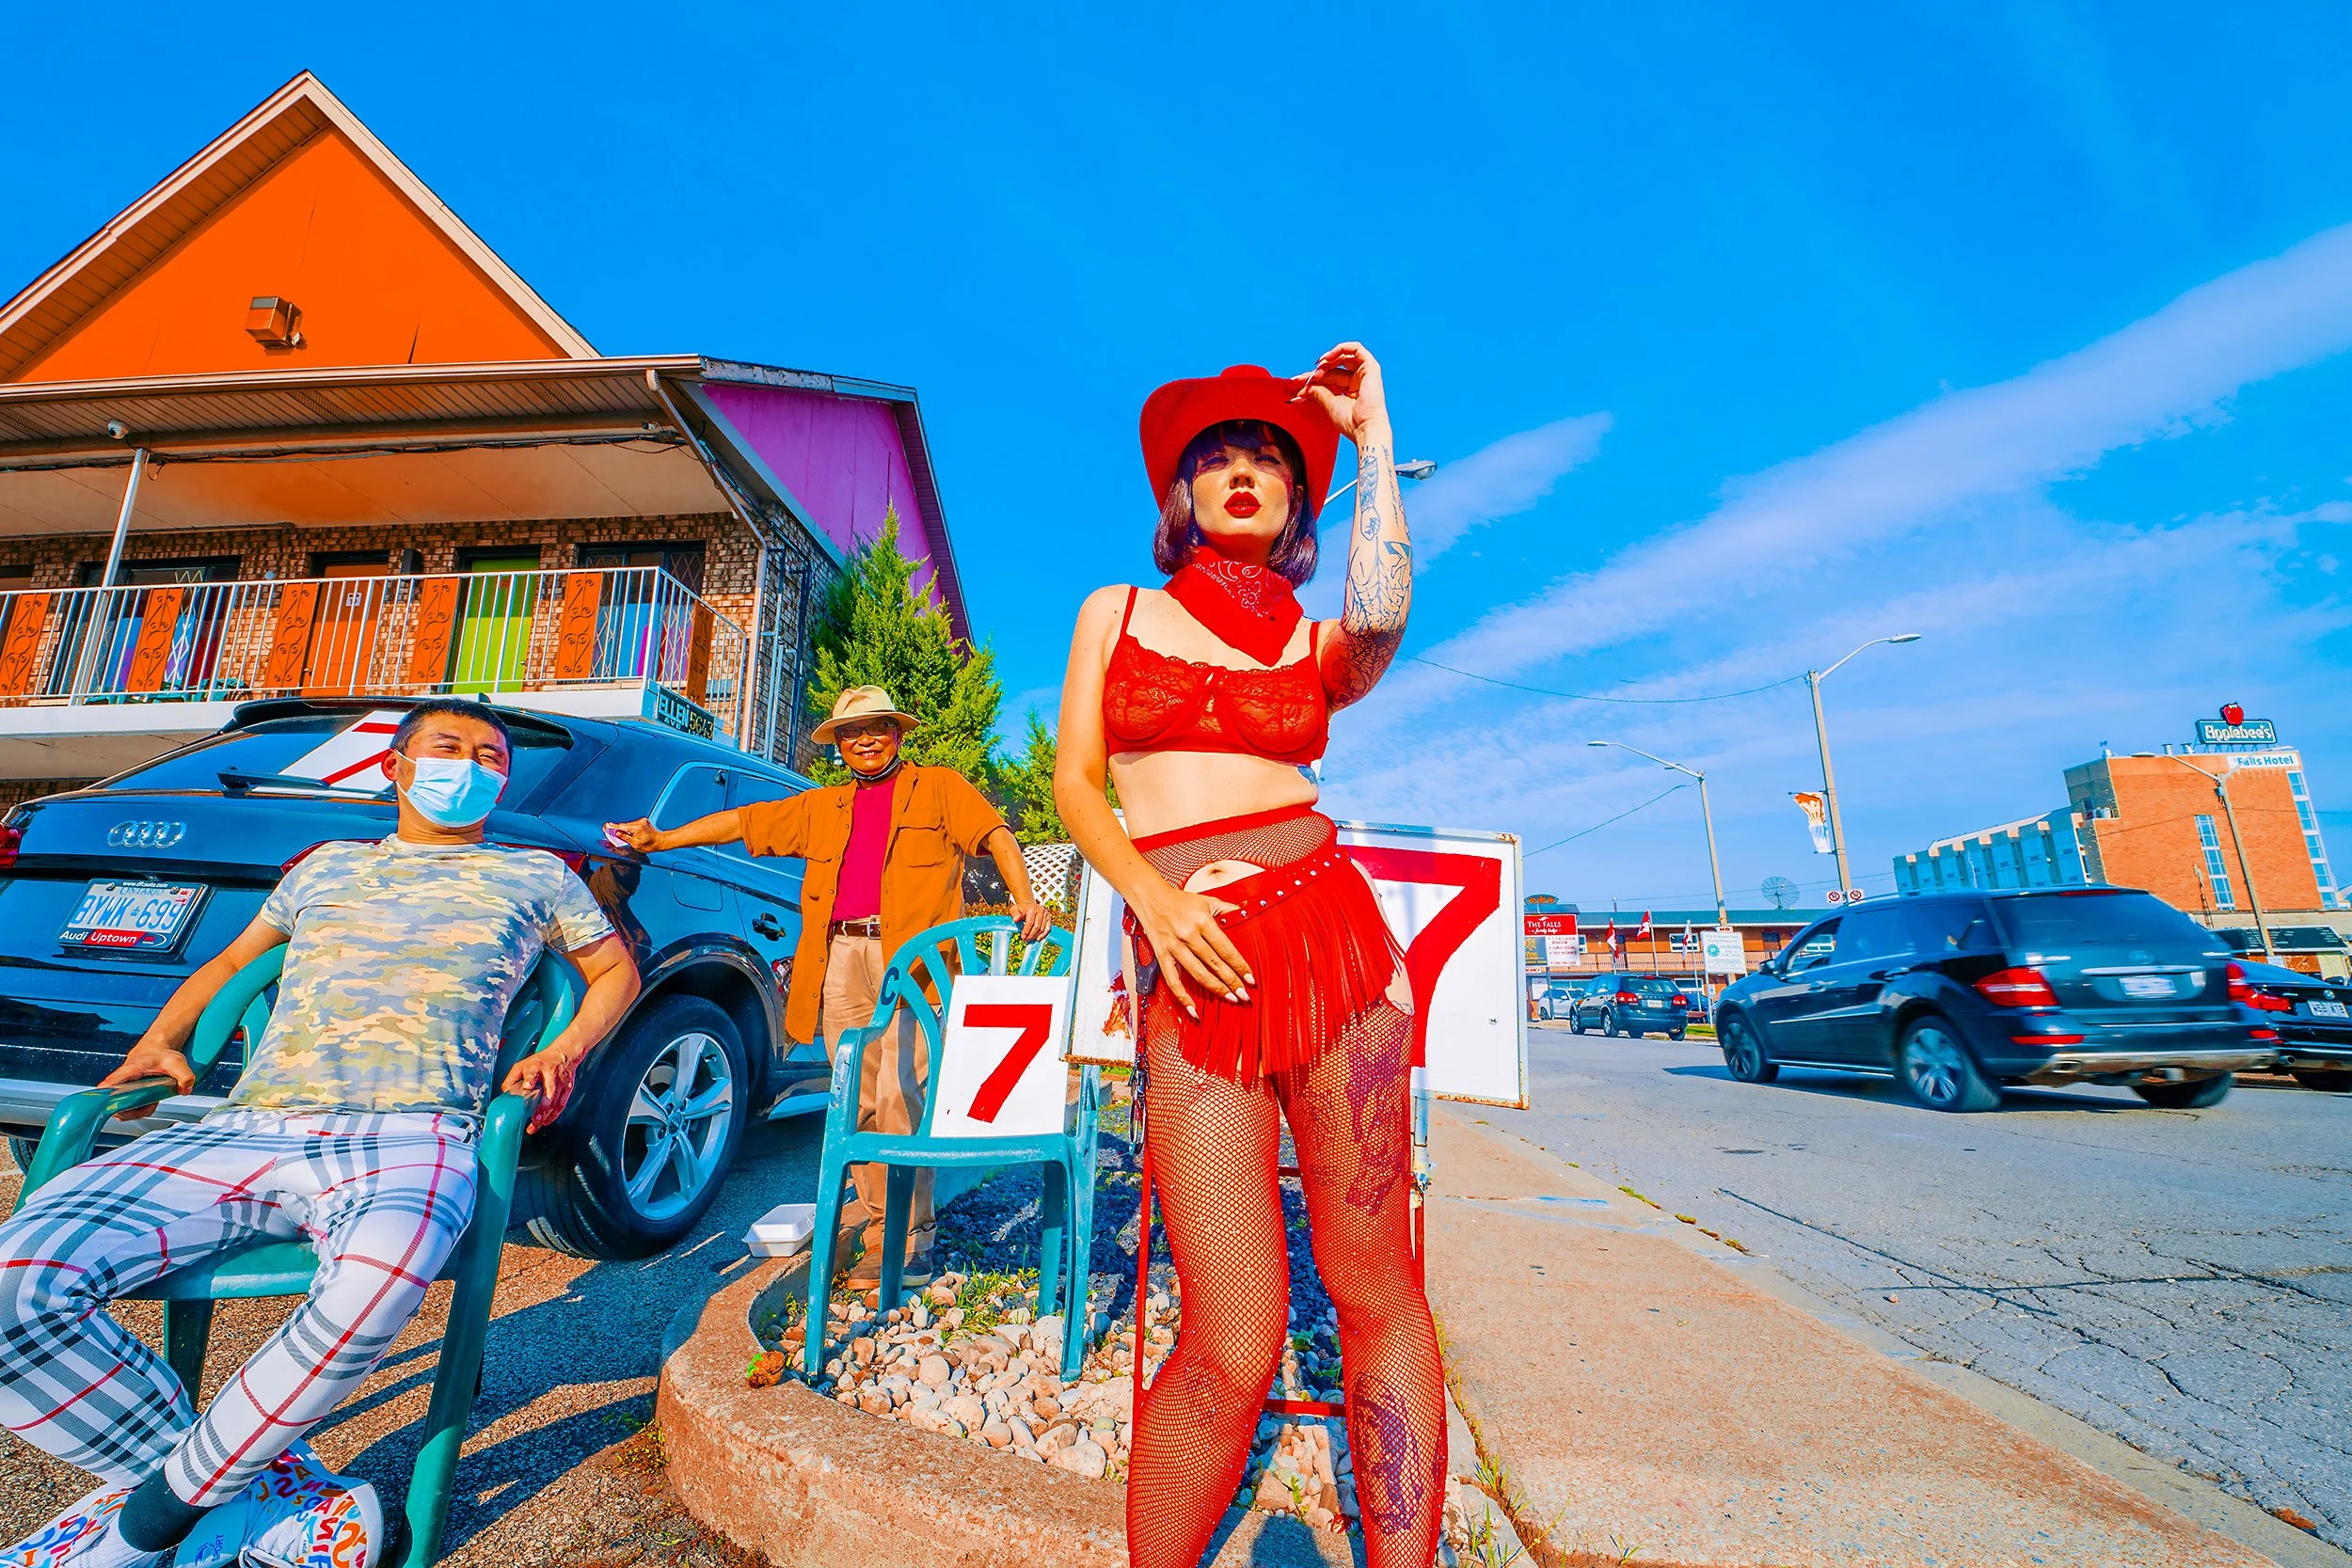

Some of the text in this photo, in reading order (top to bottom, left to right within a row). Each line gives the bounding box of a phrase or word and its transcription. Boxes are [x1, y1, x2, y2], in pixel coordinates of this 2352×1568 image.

[659, 694, 690, 728] ELLEN
[2204, 722, 2271, 742] Applebee's
[2264, 754, 2294, 766] Hotel
[70, 895, 135, 927] BYWK
[135, 898, 183, 930] 699
[58, 930, 88, 942] Audi
[90, 931, 137, 944] Uptown
[1337, 844, 1502, 1069] 7
[962, 1003, 1053, 1124] 7
[212, 1534, 225, 1562] SPORT
